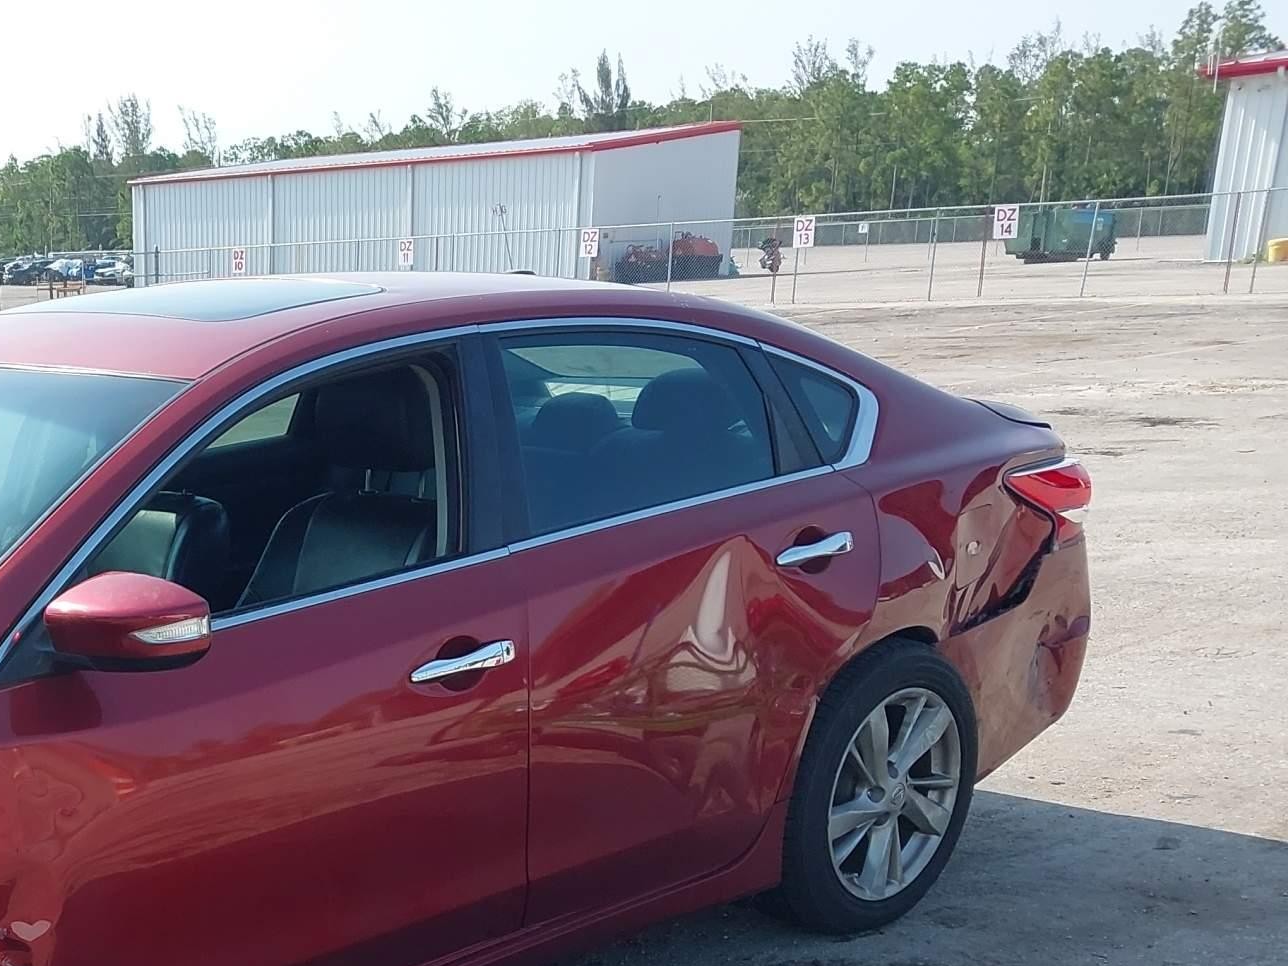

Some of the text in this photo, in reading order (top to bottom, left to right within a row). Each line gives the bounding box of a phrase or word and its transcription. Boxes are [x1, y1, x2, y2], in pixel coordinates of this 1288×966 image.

[996, 208, 1017, 222] DZ
[796, 219, 813, 232] DZ
[1000, 223, 1012, 236] 14
[582, 231, 598, 243] DZ
[799, 233, 810, 245] 13
[399, 240, 413, 252] DZ
[584, 243, 593, 255] 12
[233, 250, 245, 260] DZ
[403, 252, 409, 263] 11
[234, 261, 244, 271] 10
